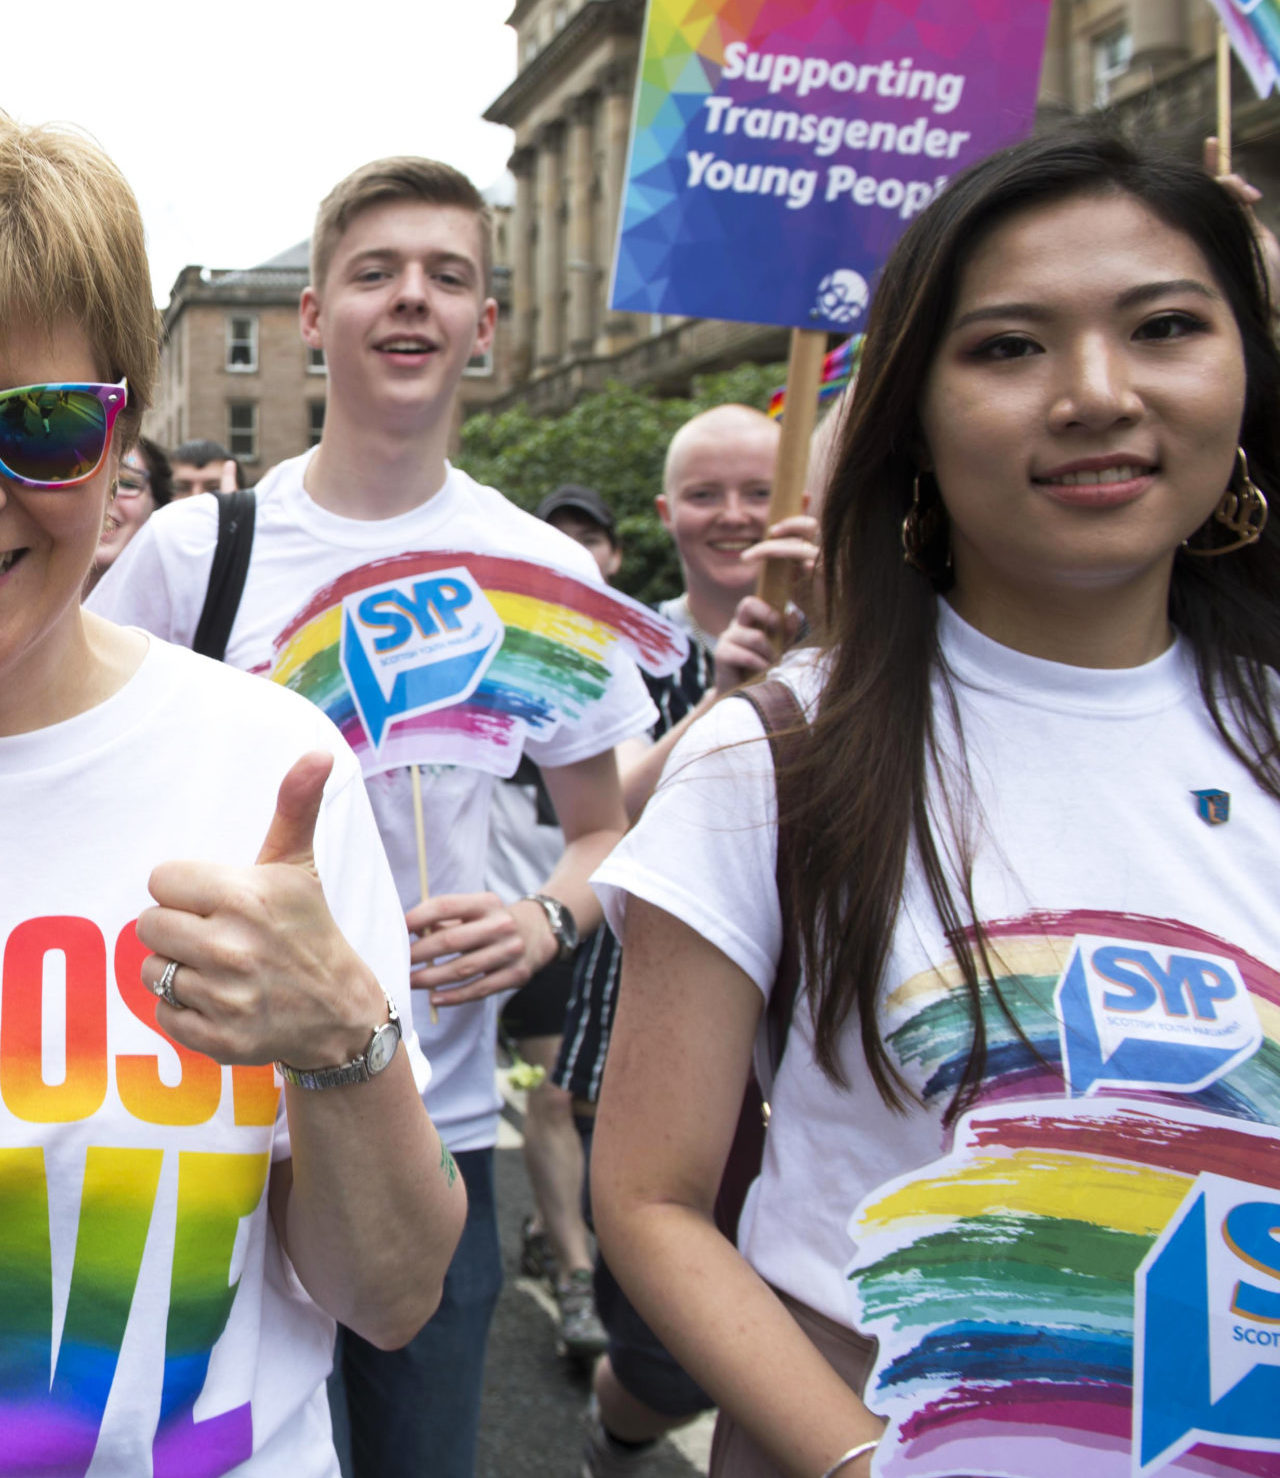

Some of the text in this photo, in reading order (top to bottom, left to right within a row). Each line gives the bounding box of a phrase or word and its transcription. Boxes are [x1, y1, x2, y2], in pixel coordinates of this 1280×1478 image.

[722, 41, 966, 113] Supporting
[704, 96, 970, 158] Transgender
[686, 151, 949, 219] Young Peopl
[358, 577, 473, 654] SYP
[1091, 945, 1237, 1021] SYP
[1232, 1325, 1280, 1348] SCOT
